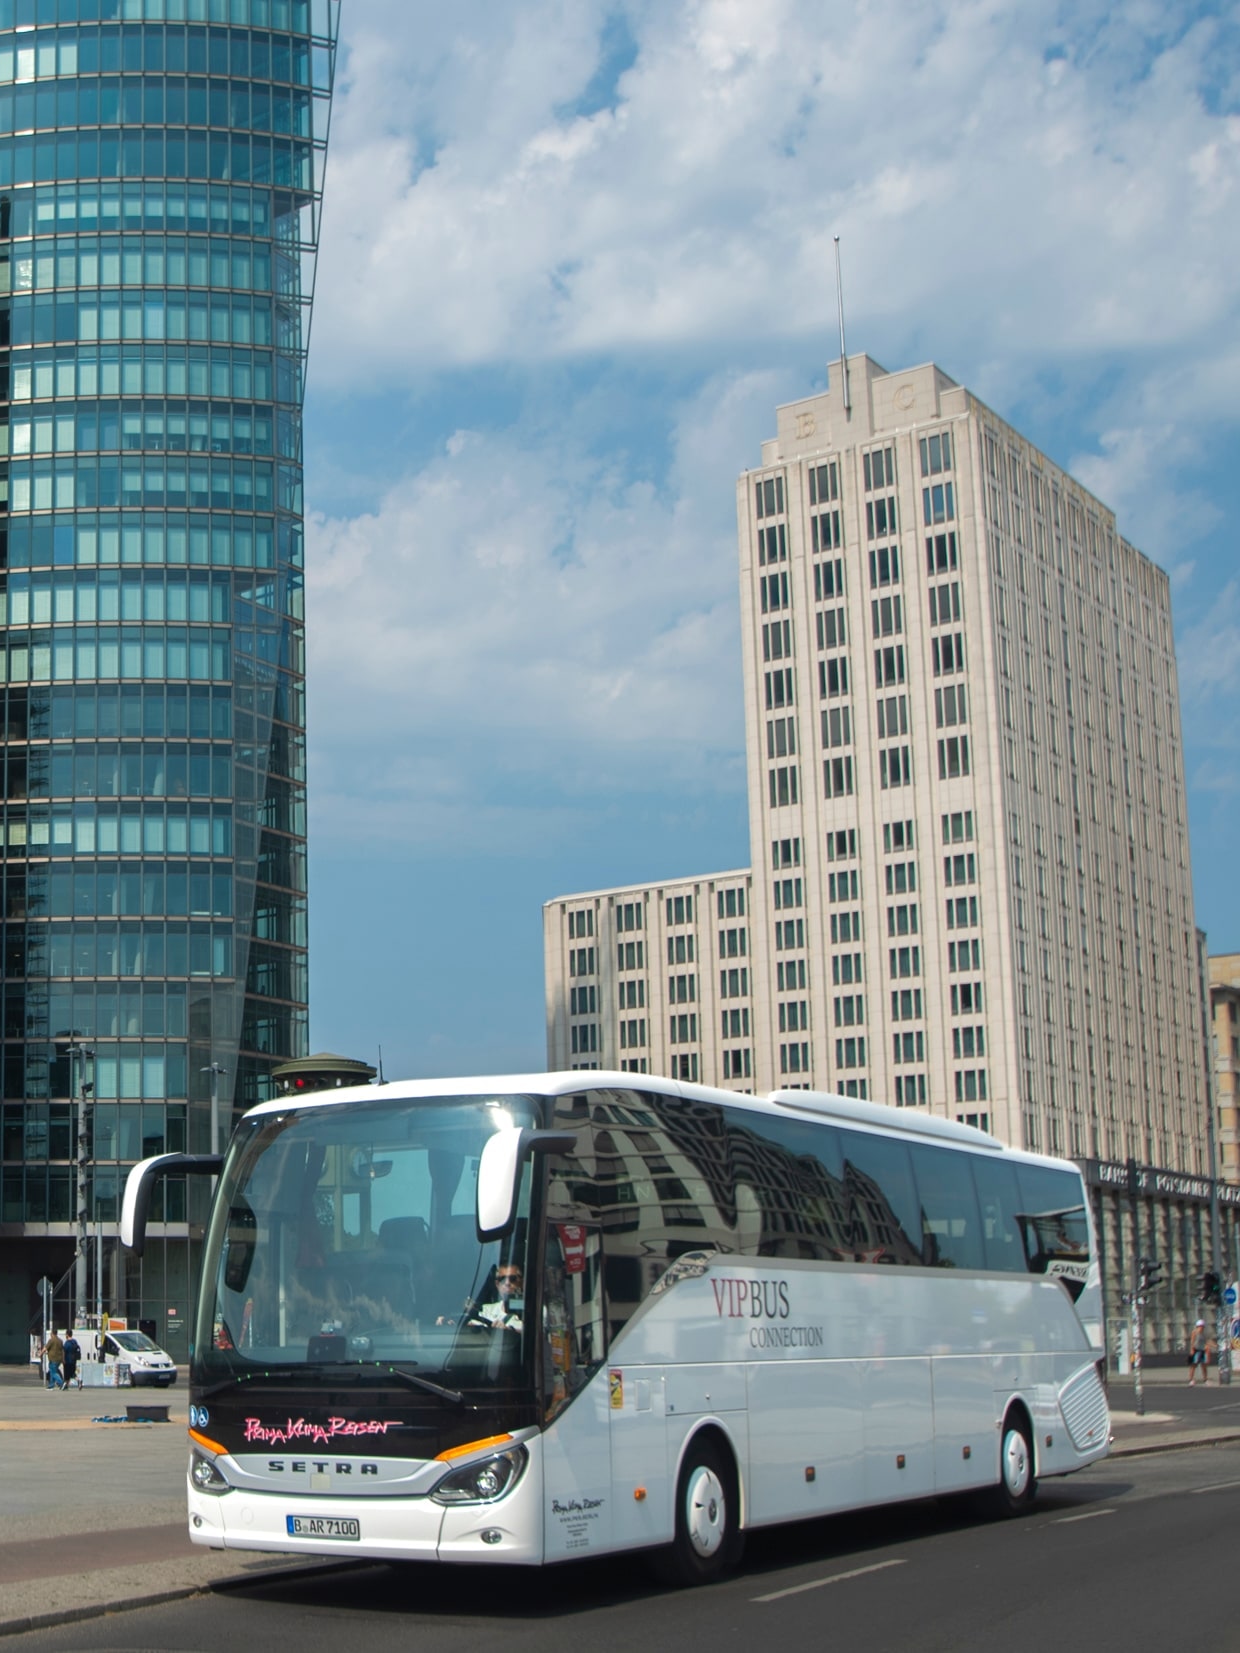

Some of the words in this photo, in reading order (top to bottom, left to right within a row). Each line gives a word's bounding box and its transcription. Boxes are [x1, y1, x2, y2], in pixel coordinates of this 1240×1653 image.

[795, 412, 816, 440] B
[749, 1326, 823, 1348] CONNECTION
[268, 1461, 378, 1475] SETRA
[294, 1519, 302, 1532] B
[309, 1519, 324, 1534] AR
[326, 1520, 357, 1536] 7100
